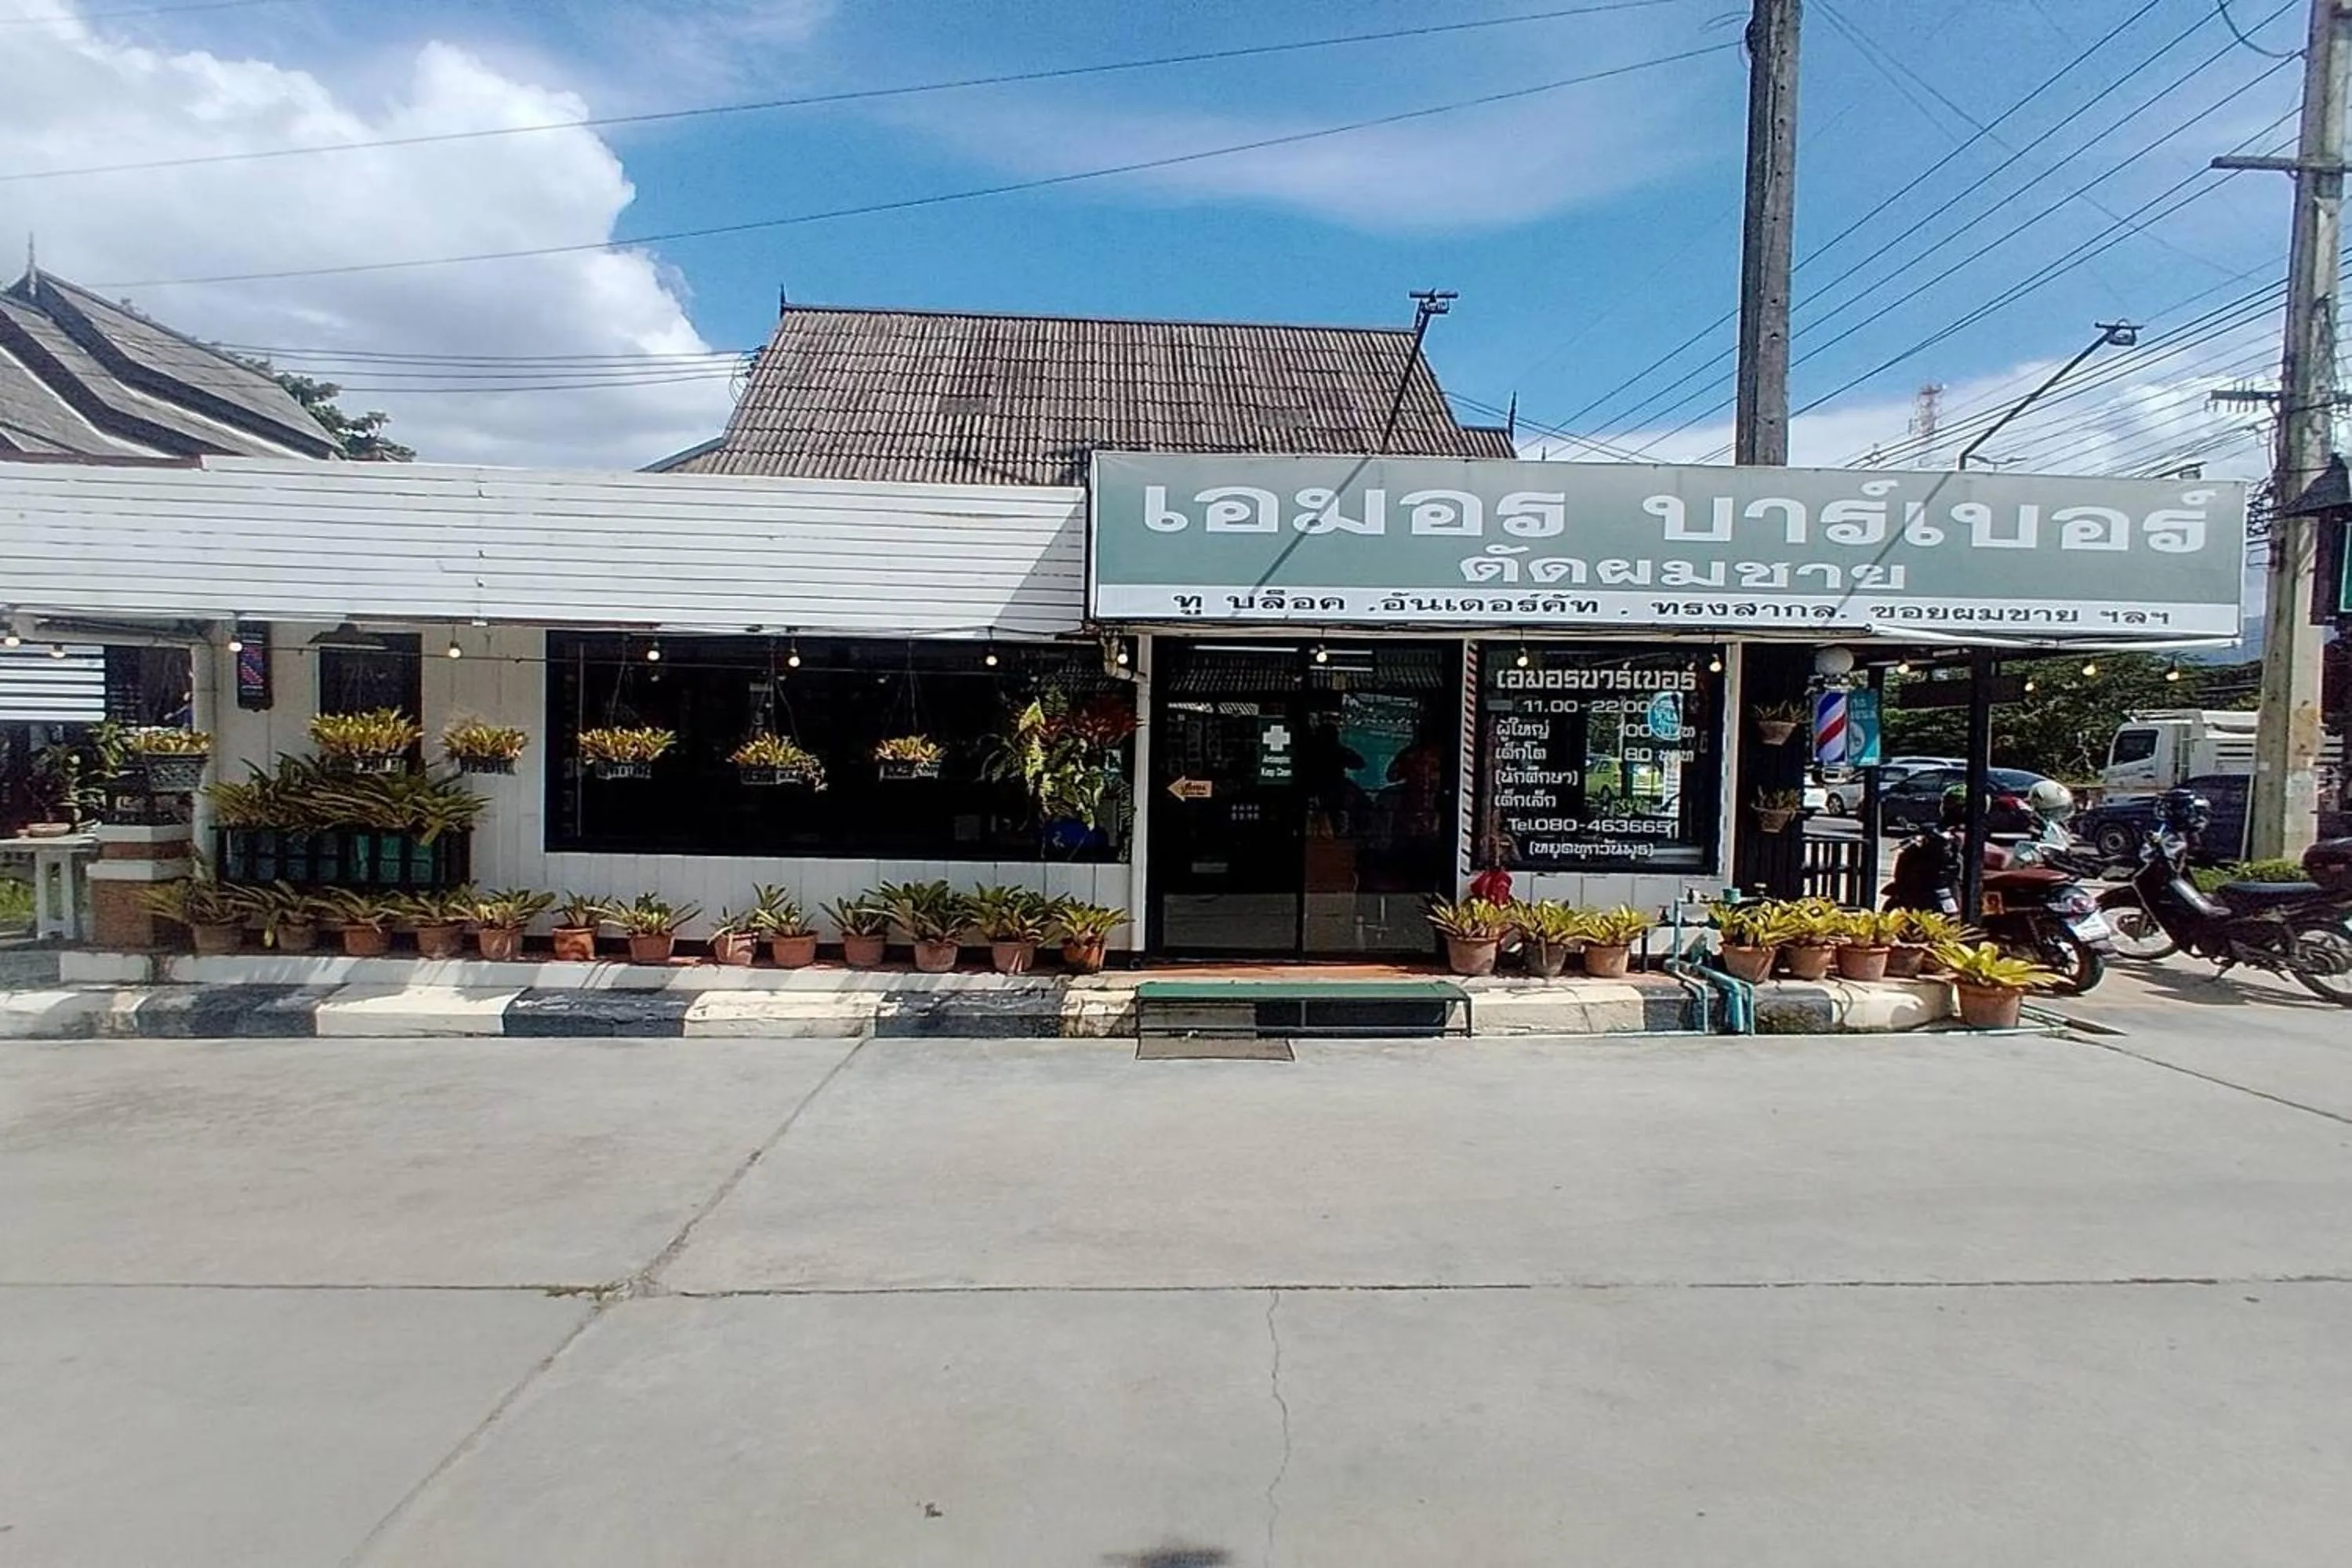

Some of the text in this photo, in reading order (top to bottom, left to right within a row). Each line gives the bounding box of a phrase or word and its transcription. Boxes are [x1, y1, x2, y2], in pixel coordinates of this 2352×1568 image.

[1144, 479, 2217, 553] เอมอร บาร์เบอร์
[1460, 544, 1905, 590] ตัดผมชาย
[1173, 594, 1203, 615] ทู
[1496, 662, 1697, 690] เอมอรบาร์เบอร์
[1496, 717, 1550, 742] ผู้ใหญ่
[1624, 747, 1652, 763] 80
